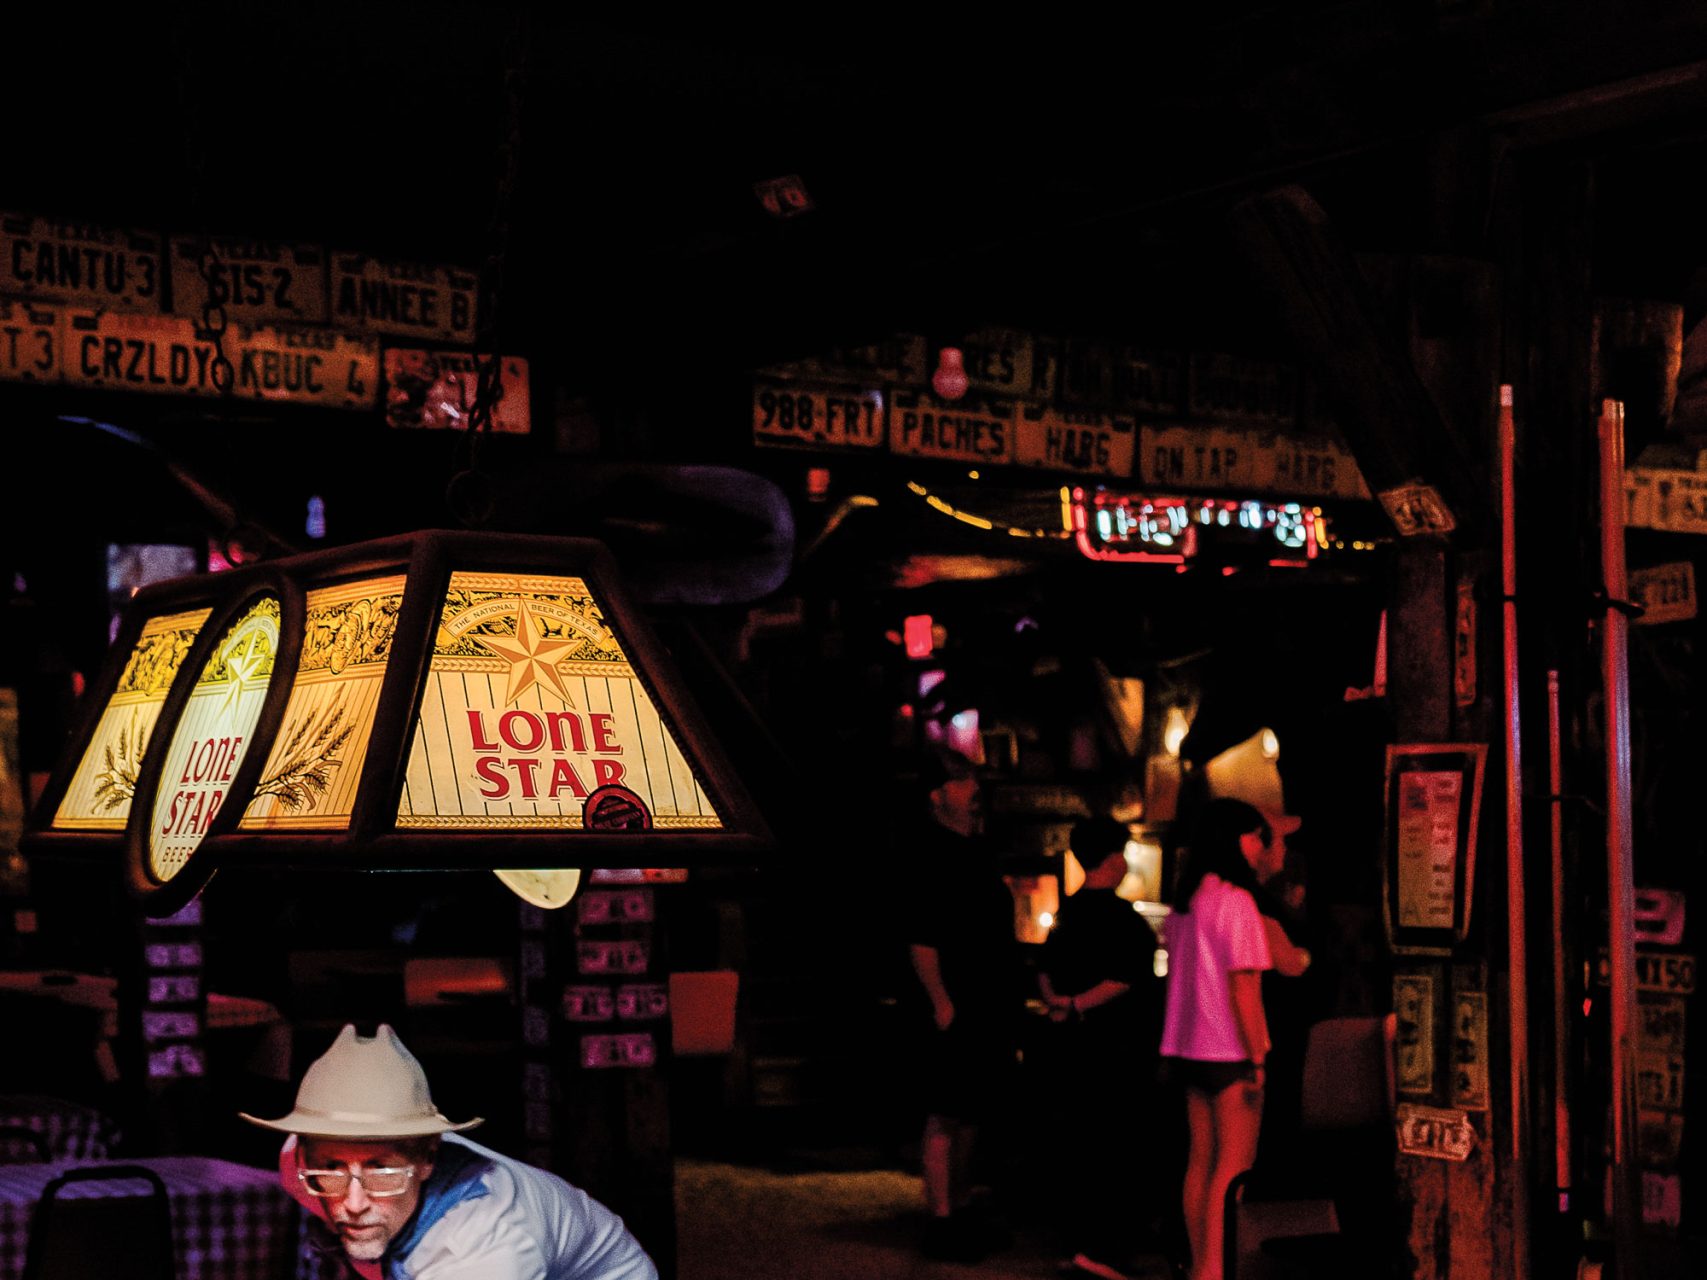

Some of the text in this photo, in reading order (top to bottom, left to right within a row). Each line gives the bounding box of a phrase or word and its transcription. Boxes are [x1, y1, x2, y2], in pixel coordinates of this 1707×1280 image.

[339, 277, 438, 327] ANNEE
[35, 331, 53, 369] 3
[81, 336, 210, 387] CRZLDY
[240, 350, 365, 395] KBUC 4
[902, 411, 1005, 455] PACHES
[1194, 447, 1237, 483] TAP
[454, 603, 515, 630] THE NATIONAL
[530, 604, 598, 636] BEER OF TEXAS
[466, 710, 623, 755] LONE
[181, 736, 243, 785] LONE
